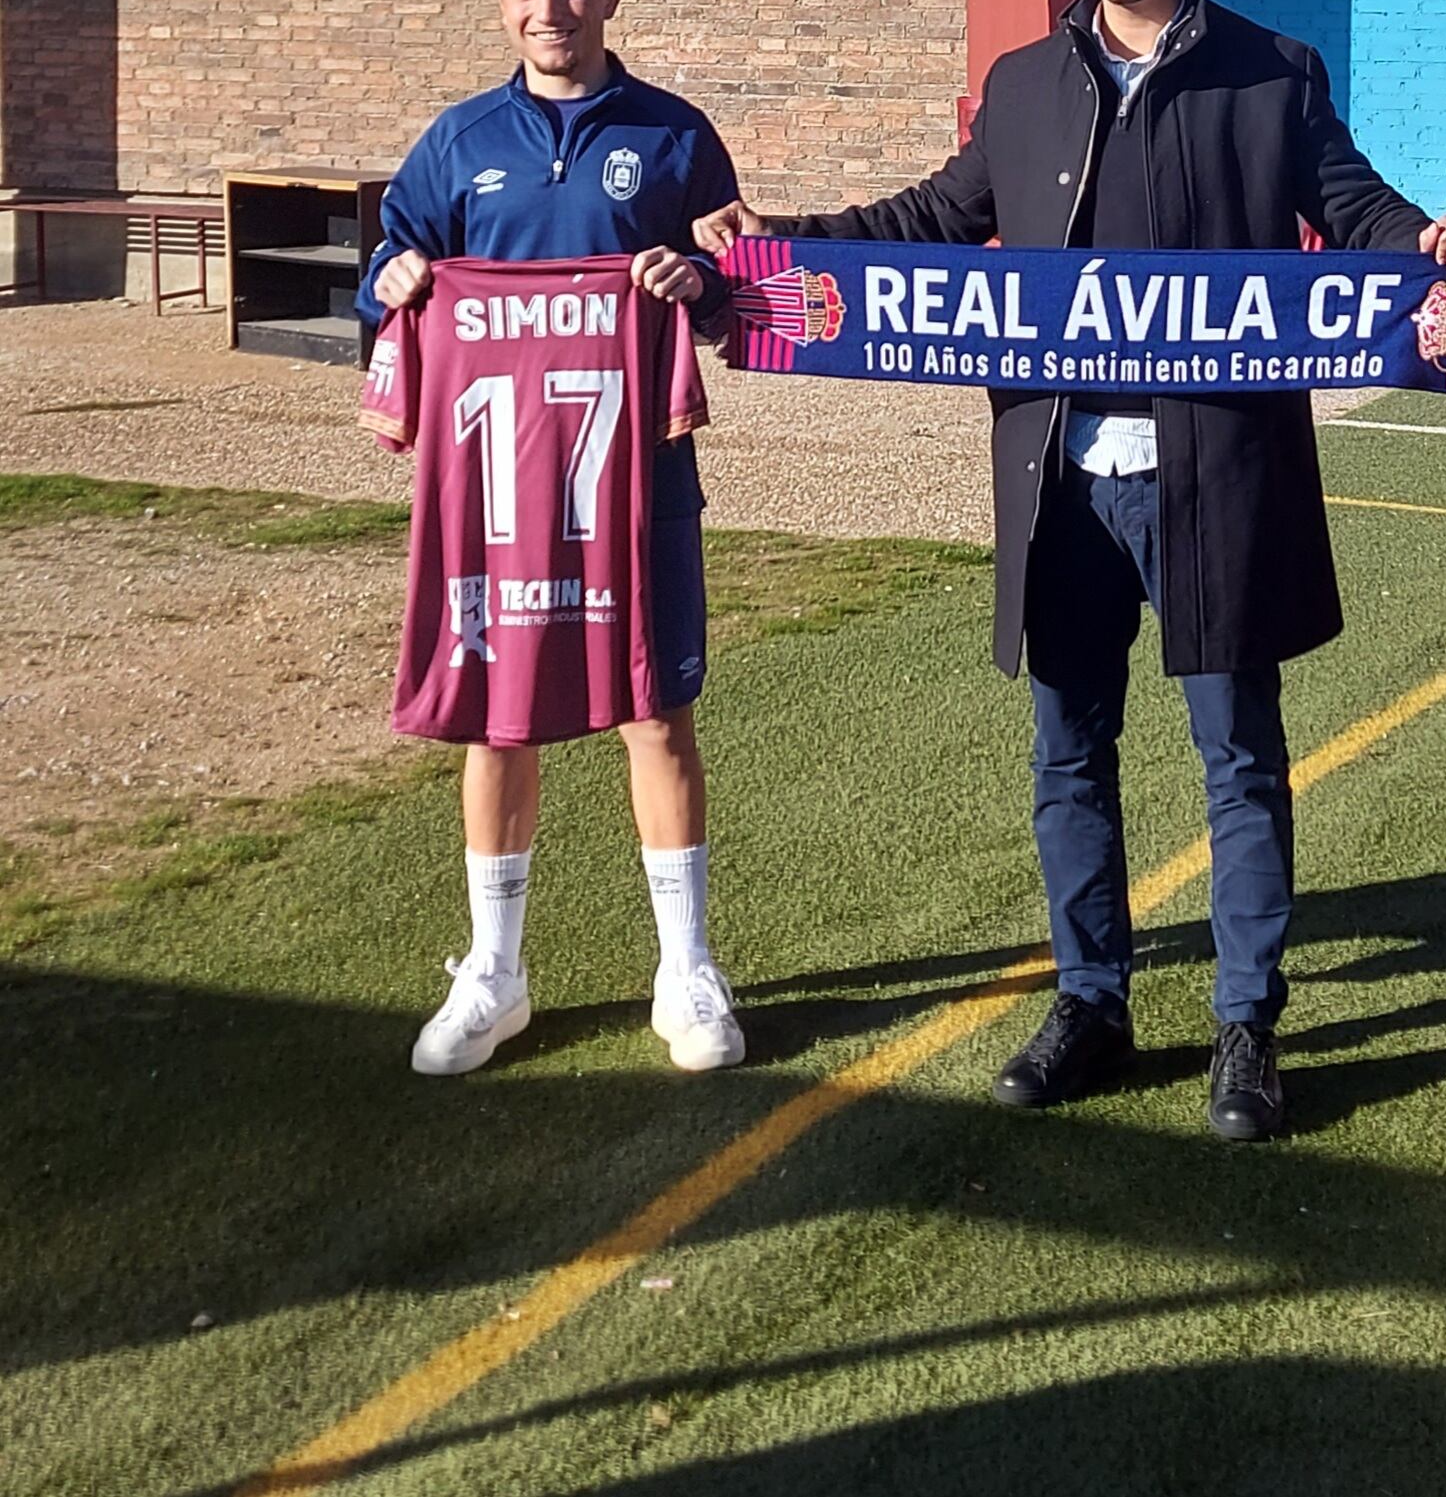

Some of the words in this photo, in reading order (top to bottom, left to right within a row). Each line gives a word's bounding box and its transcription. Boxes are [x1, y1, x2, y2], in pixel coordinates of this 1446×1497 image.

[454, 274, 617, 341] SIMÓN
[864, 264, 1038, 339] REAL
[1063, 258, 1278, 342] ÁVILA
[1306, 274, 1401, 339] CF
[862, 341, 914, 373] 100
[922, 344, 990, 379] Años
[1000, 347, 1033, 379] de
[1043, 350, 1218, 384] Sentimiento
[1230, 347, 1384, 382] Encarnado
[454, 370, 623, 544] 17
